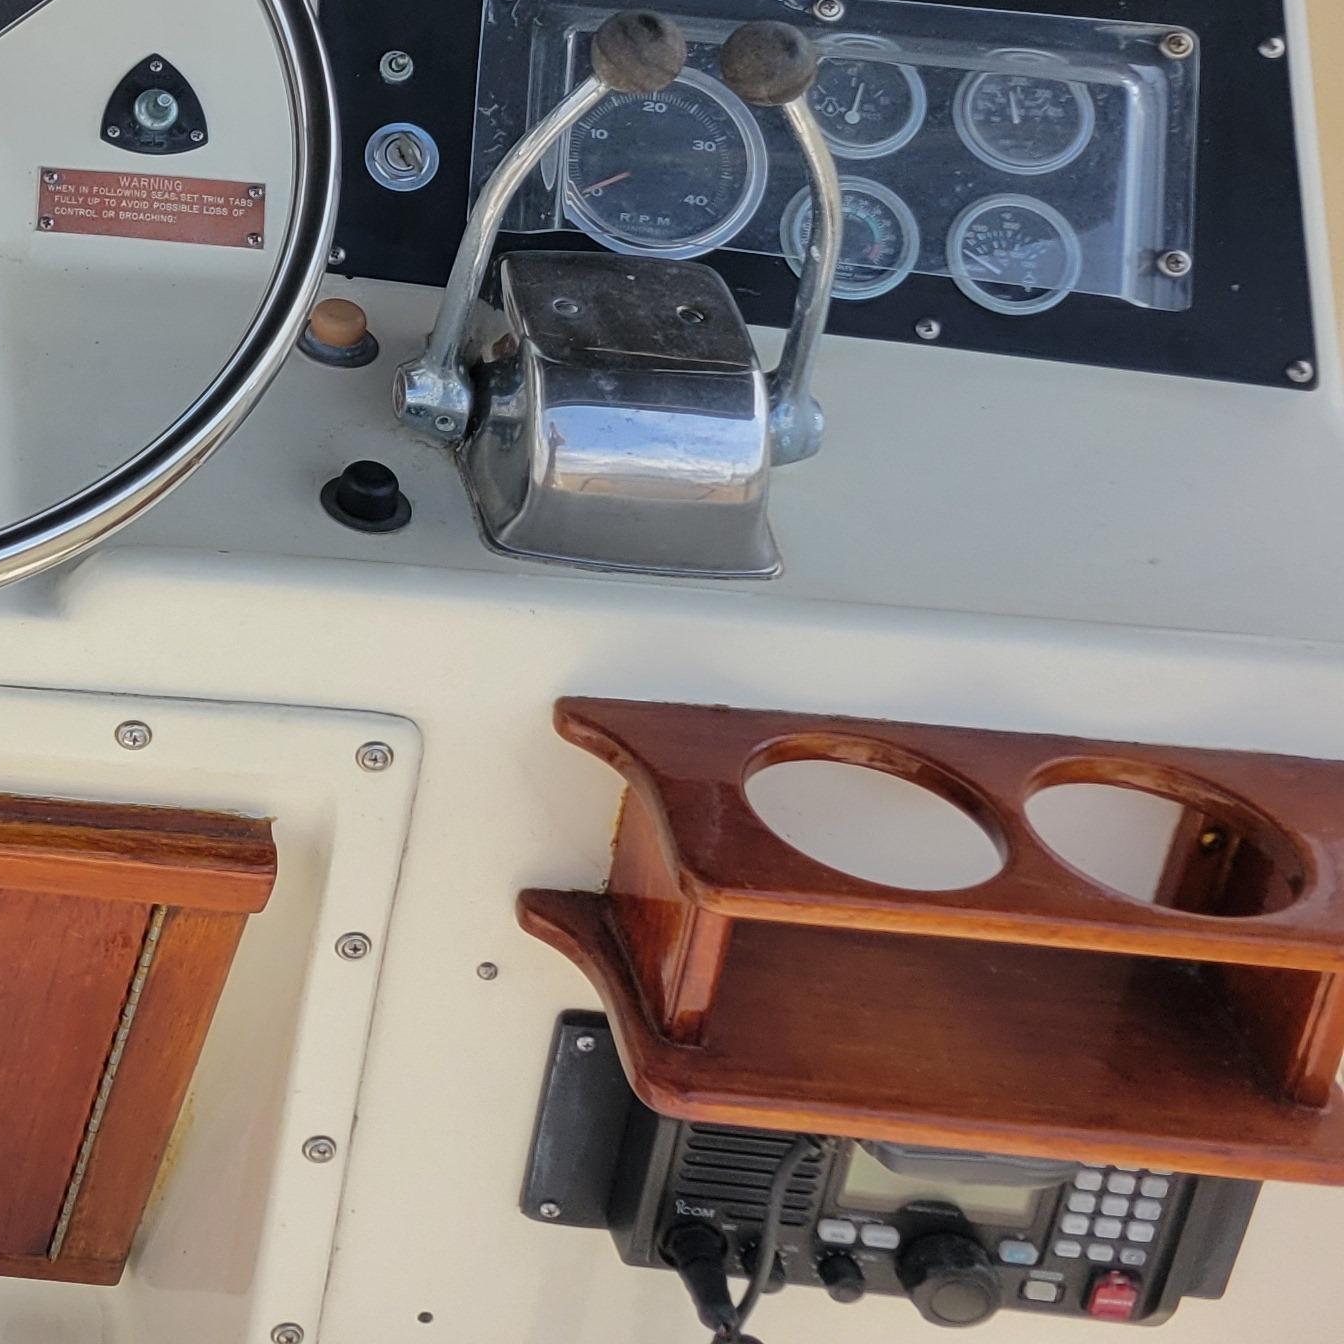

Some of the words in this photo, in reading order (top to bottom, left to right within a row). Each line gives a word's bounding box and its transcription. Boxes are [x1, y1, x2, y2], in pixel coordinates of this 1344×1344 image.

[642, 101, 667, 113] 20
[590, 128, 609, 140] 10
[692, 140, 717, 152] 30
[119, 175, 183, 191] WARNING
[48, 184, 75, 193] WHEN
[79, 185, 89, 194] IN
[92, 186, 147, 198] FOLLOWING
[180, 193, 199, 202] SET
[201, 195, 225, 205] TRIM
[228, 197, 253, 207] TABS
[591, 187, 603, 197] 0
[54, 194, 84, 204] FULLY
[88, 197, 101, 206] UP
[104, 198, 117, 207] TO
[120, 199, 149, 209] AVOID
[153, 201, 200, 214] POSSIBLE
[203, 206, 229, 216] LOSS
[232, 208, 246, 217] OF
[683, 194, 708, 207] 40
[54, 206, 99, 218] CONTROL
[102, 210, 115, 219] OR
